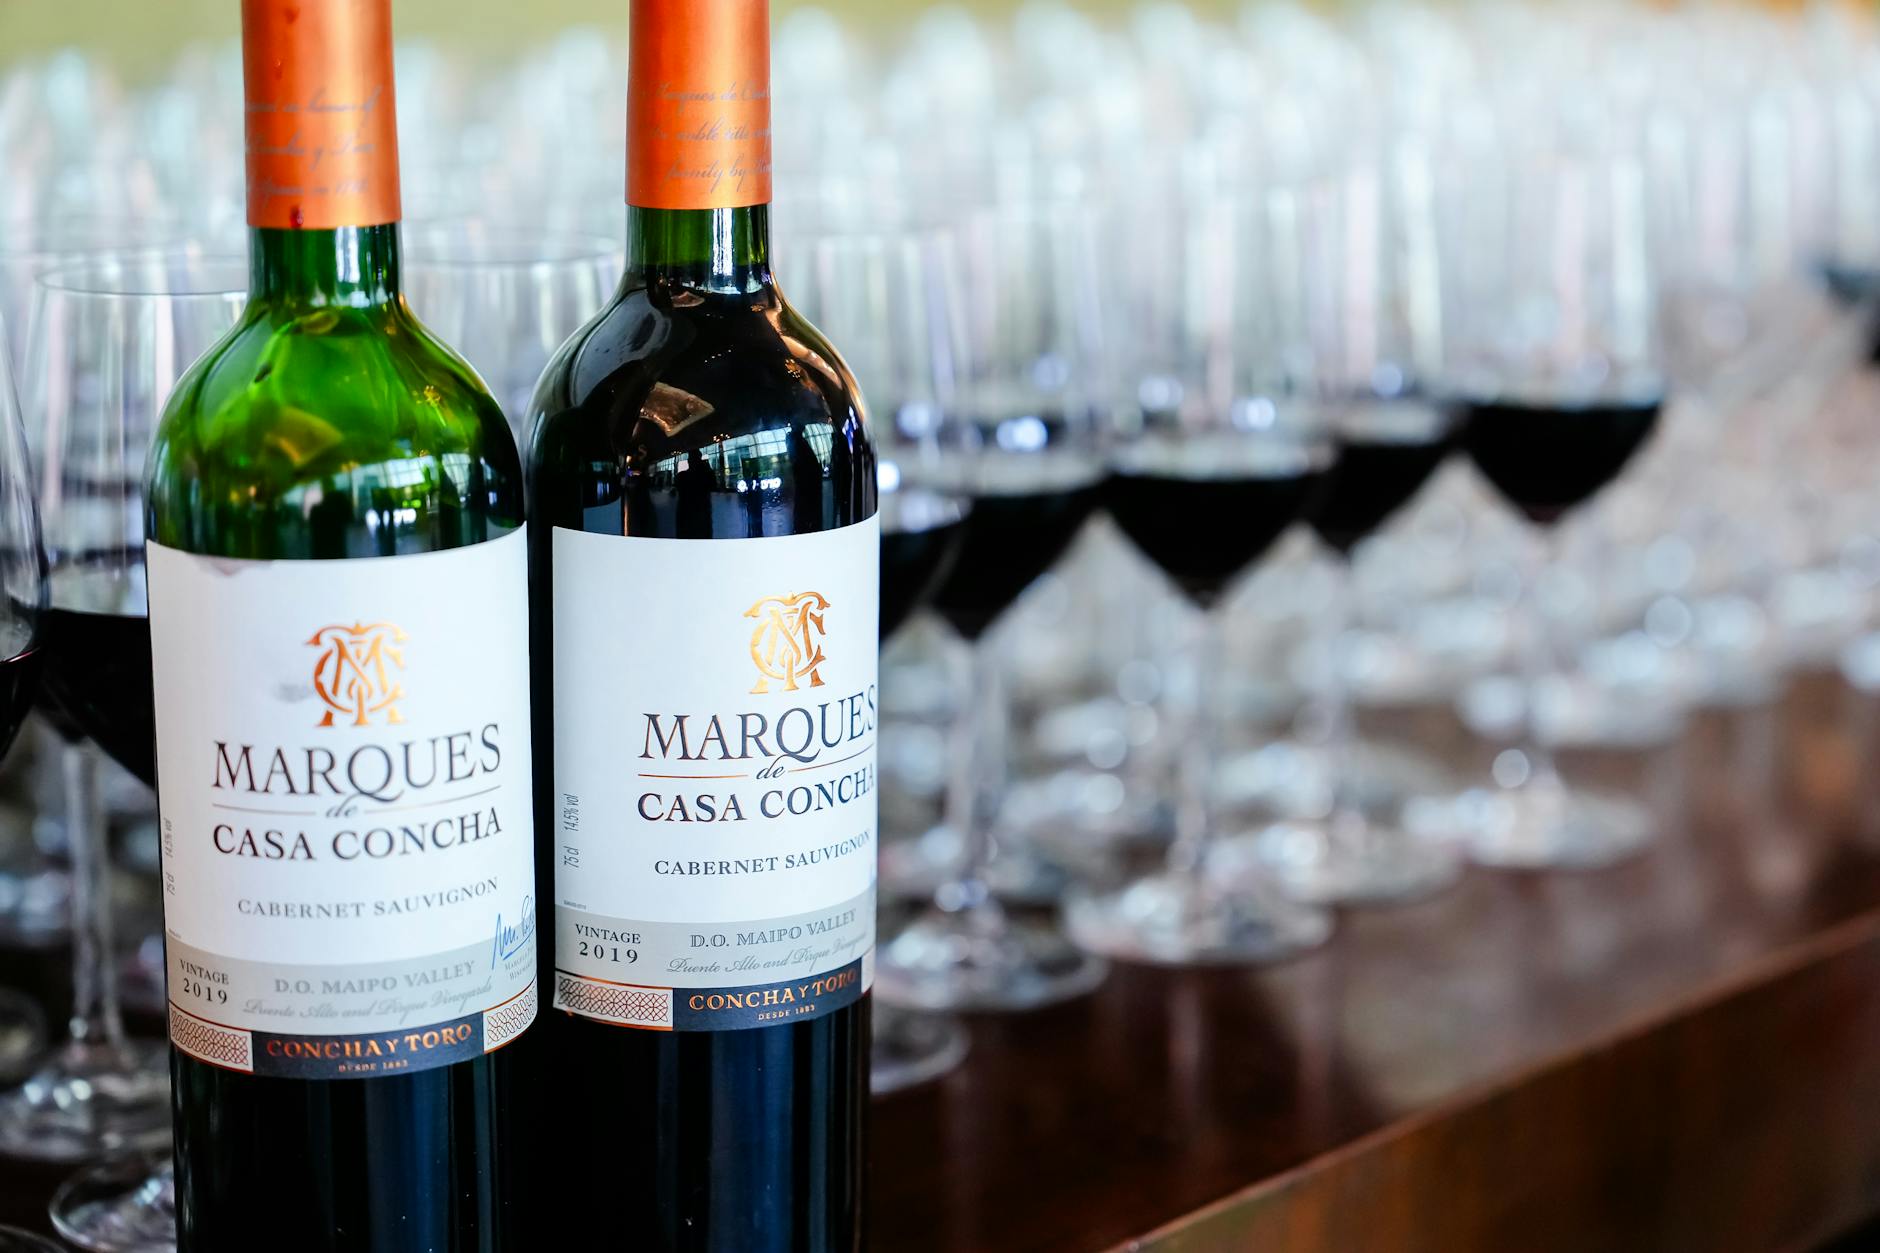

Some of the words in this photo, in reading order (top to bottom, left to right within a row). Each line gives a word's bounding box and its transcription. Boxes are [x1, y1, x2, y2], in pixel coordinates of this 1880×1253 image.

[638, 684, 876, 763] MARQUES
[212, 723, 501, 802] MARQUES
[756, 755, 786, 779] de
[325, 793, 358, 818] de
[637, 792, 748, 823] CASA
[759, 762, 875, 819] CONCHA
[213, 824, 317, 861] CASA
[331, 807, 502, 861] CONCHA
[563, 808, 579, 831] 14.5%
[563, 856, 579, 869] 75
[655, 856, 779, 876] CABERNET
[785, 829, 872, 869] SAUVIGNON
[237, 899, 365, 919] CABERNET
[373, 877, 499, 916] SAUVIGNON
[575, 923, 641, 945] VINTAGE
[690, 934, 730, 948] D.O.
[737, 926, 802, 946] MAIPO
[806, 908, 857, 935] VALLEY
[578, 941, 638, 964] 2019
[666, 957, 721, 973] Puente
[725, 954, 760, 973] Alto
[762, 950, 793, 969] and
[179, 959, 229, 985] VINTAGE
[274, 979, 315, 995] D.O.
[321, 977, 397, 995] MAIPO
[403, 960, 474, 987] VALLEY
[183, 977, 228, 1004] 2019
[689, 987, 795, 1010] CONCHA
[798, 985, 809, 998] Y
[811, 967, 857, 997] TORO
[758, 1009, 791, 1021] DESDE
[266, 1039, 382, 1060] CONCHA
[385, 1038, 399, 1054] Y
[403, 1023, 472, 1052] TORO
